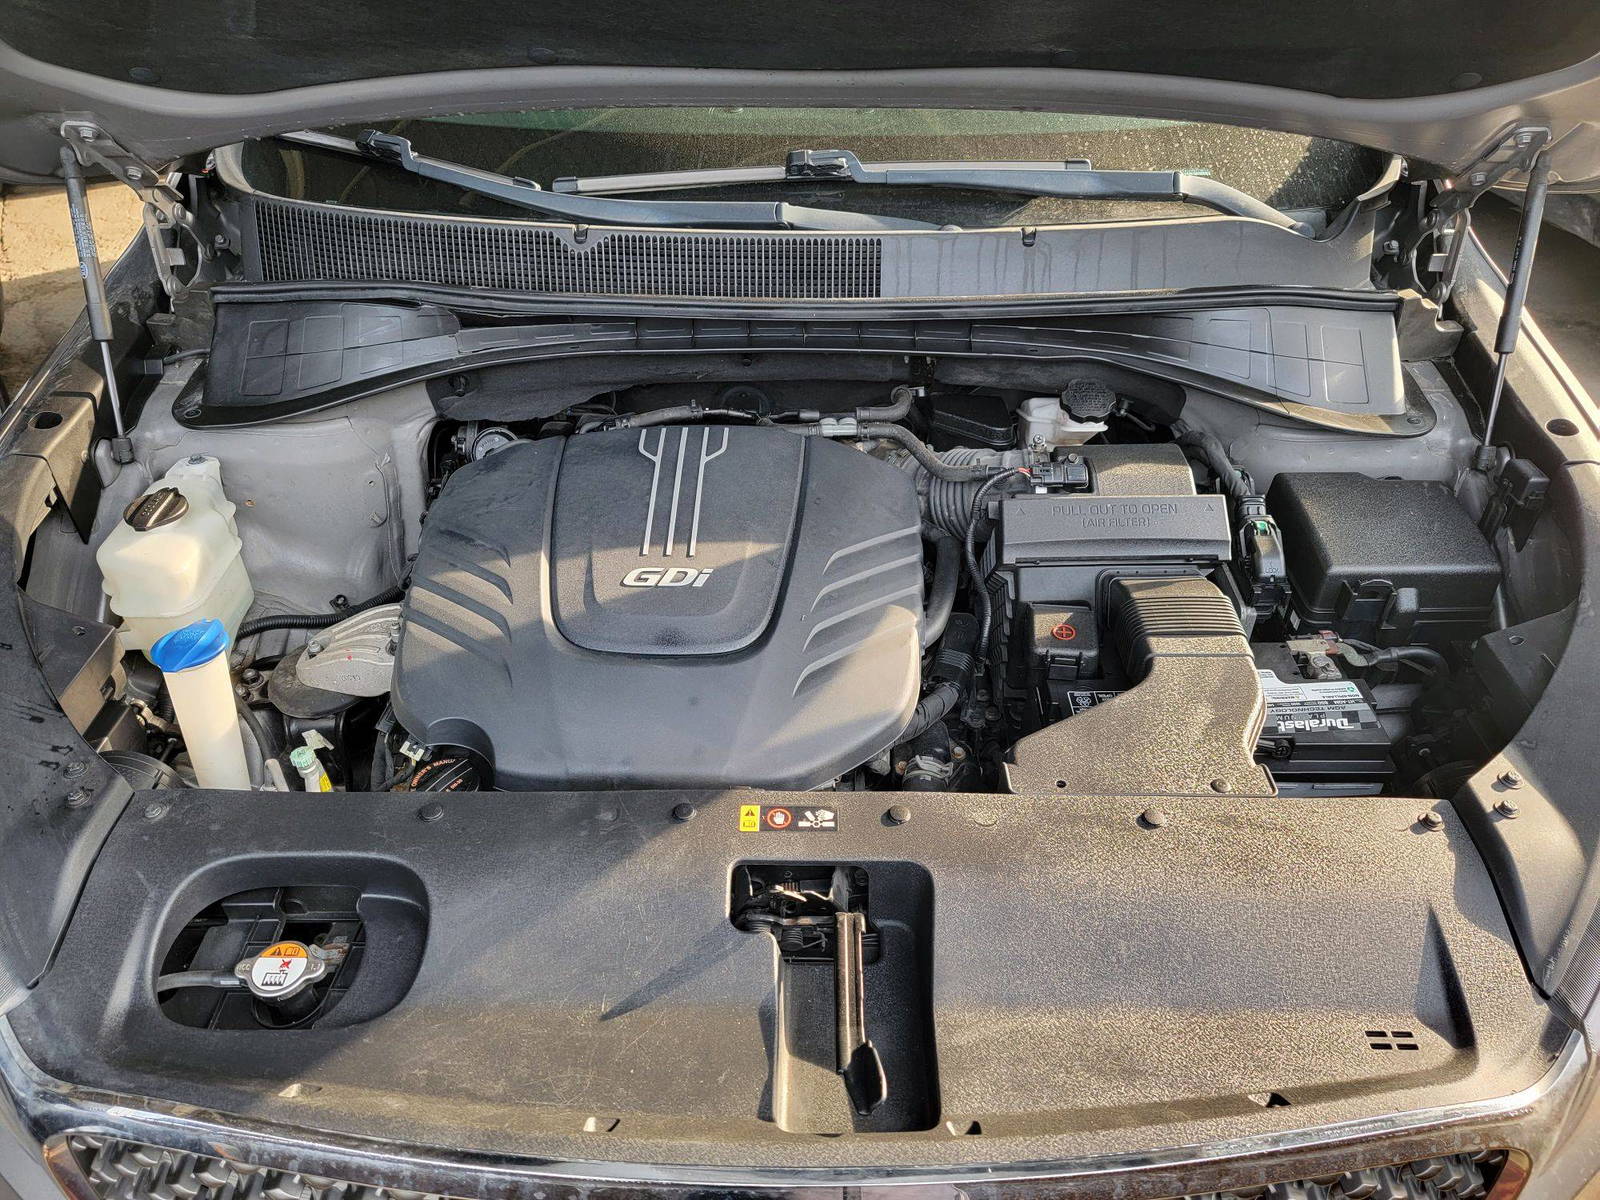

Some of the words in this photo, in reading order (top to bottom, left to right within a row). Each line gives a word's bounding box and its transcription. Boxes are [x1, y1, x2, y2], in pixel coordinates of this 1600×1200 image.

[1051, 505, 1086, 516] PULL
[1089, 504, 1116, 515] OUT
[1121, 504, 1138, 515] TO
[1141, 503, 1178, 514] OPEN
[619, 567, 714, 588] GDi
[1277, 718, 1354, 732] Duralast
